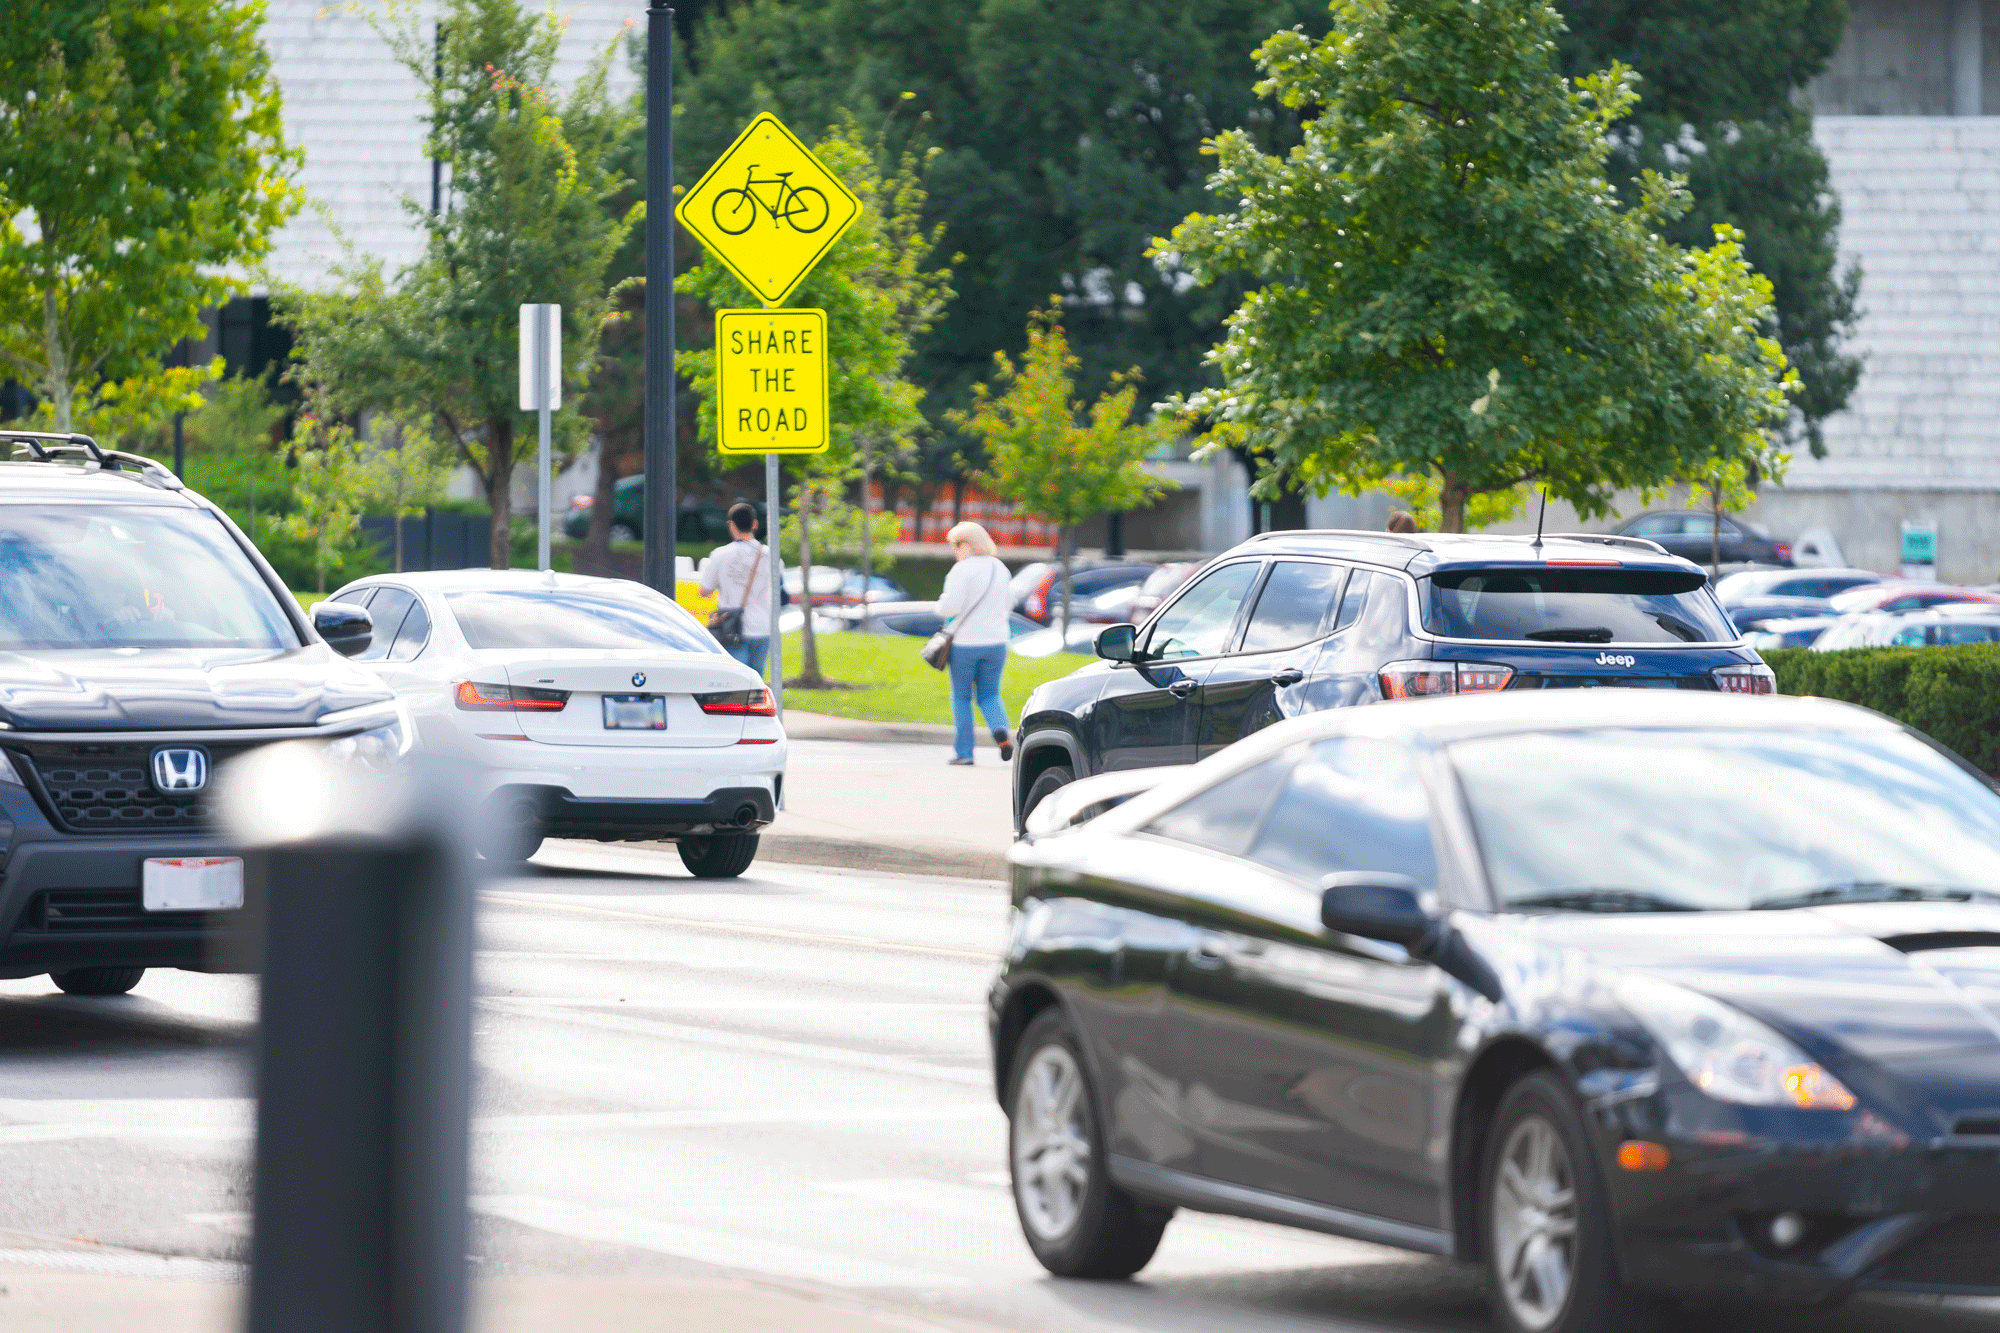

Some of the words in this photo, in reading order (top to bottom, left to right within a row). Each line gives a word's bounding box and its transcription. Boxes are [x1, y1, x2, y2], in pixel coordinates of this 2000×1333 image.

[731, 330, 813, 354] SHARE
[750, 368, 796, 393] THE
[738, 407, 808, 432] ROAD
[1595, 651, 1636, 668] Jeep
